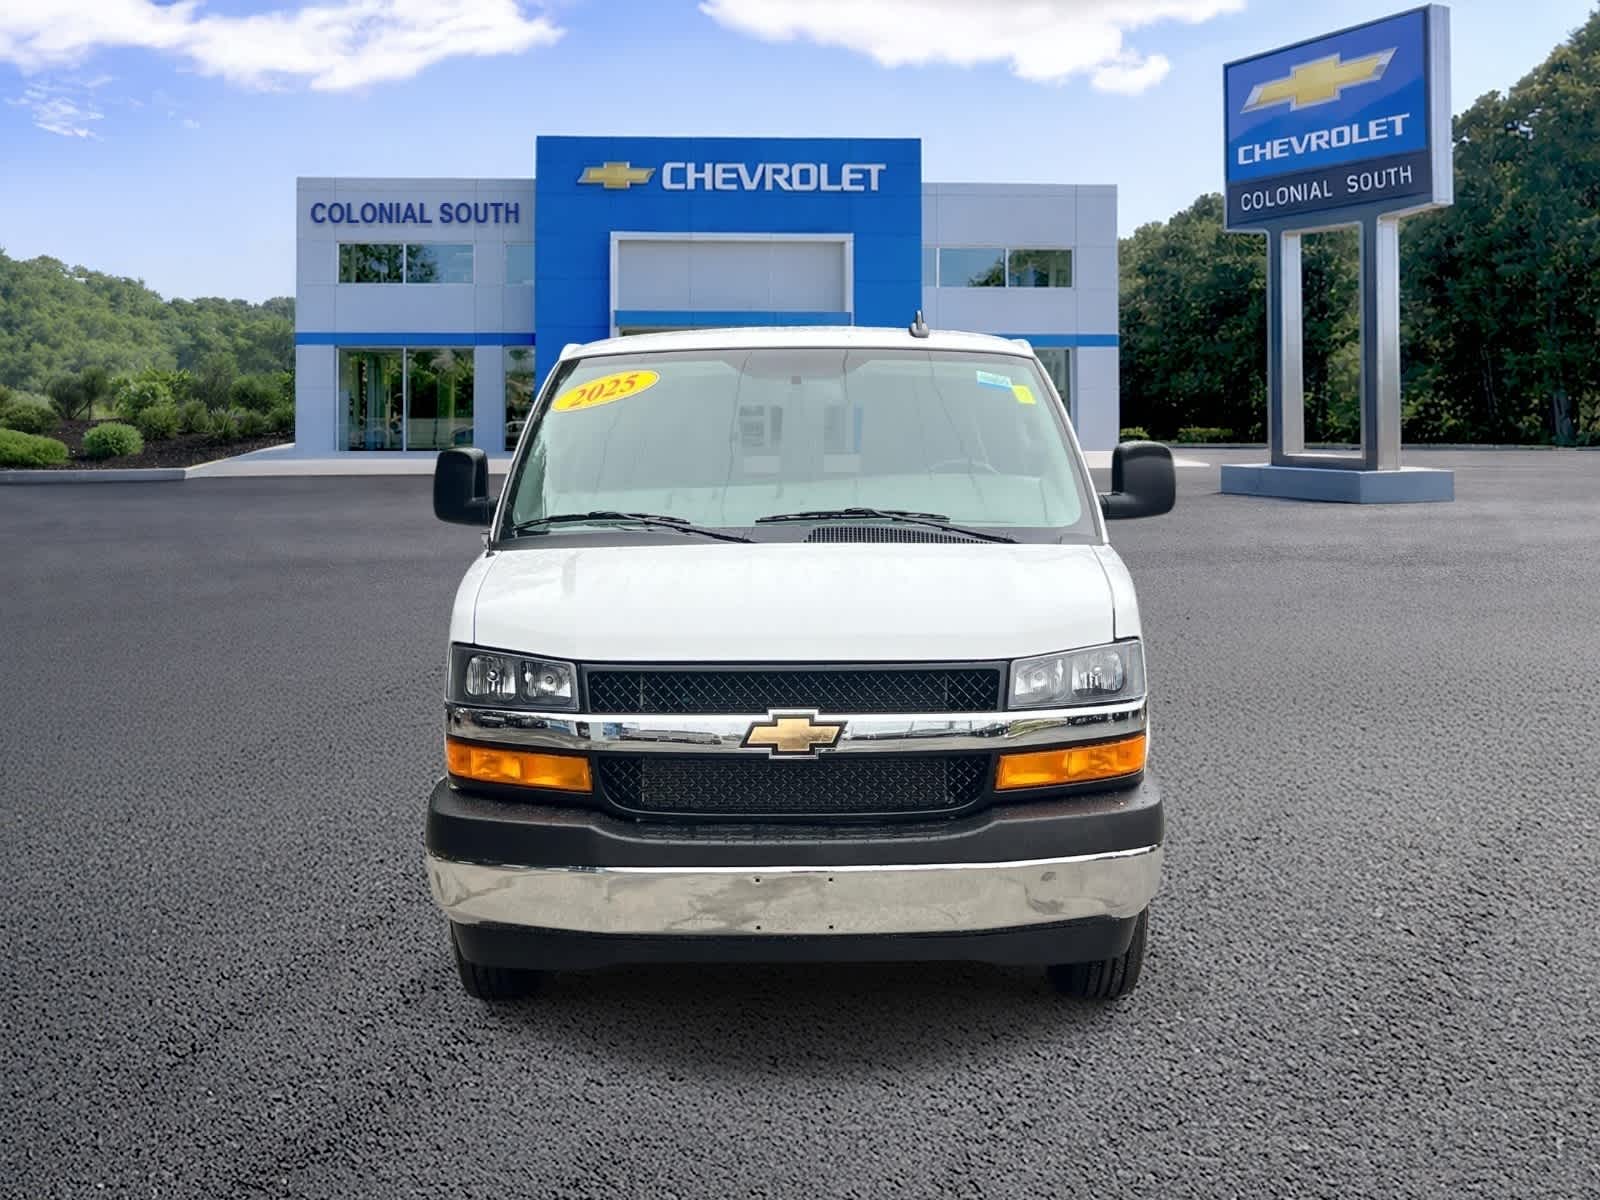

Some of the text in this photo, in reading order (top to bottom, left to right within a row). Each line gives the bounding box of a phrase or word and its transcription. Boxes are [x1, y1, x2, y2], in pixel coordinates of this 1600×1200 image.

[1237, 113, 1410, 165] CHEVROLET
[662, 162, 887, 192] CHEVROLET
[1240, 165, 1412, 211] COLONIAL SOUTH
[310, 202, 520, 224] COLONIAL SOUTH
[569, 374, 639, 408] 2025
